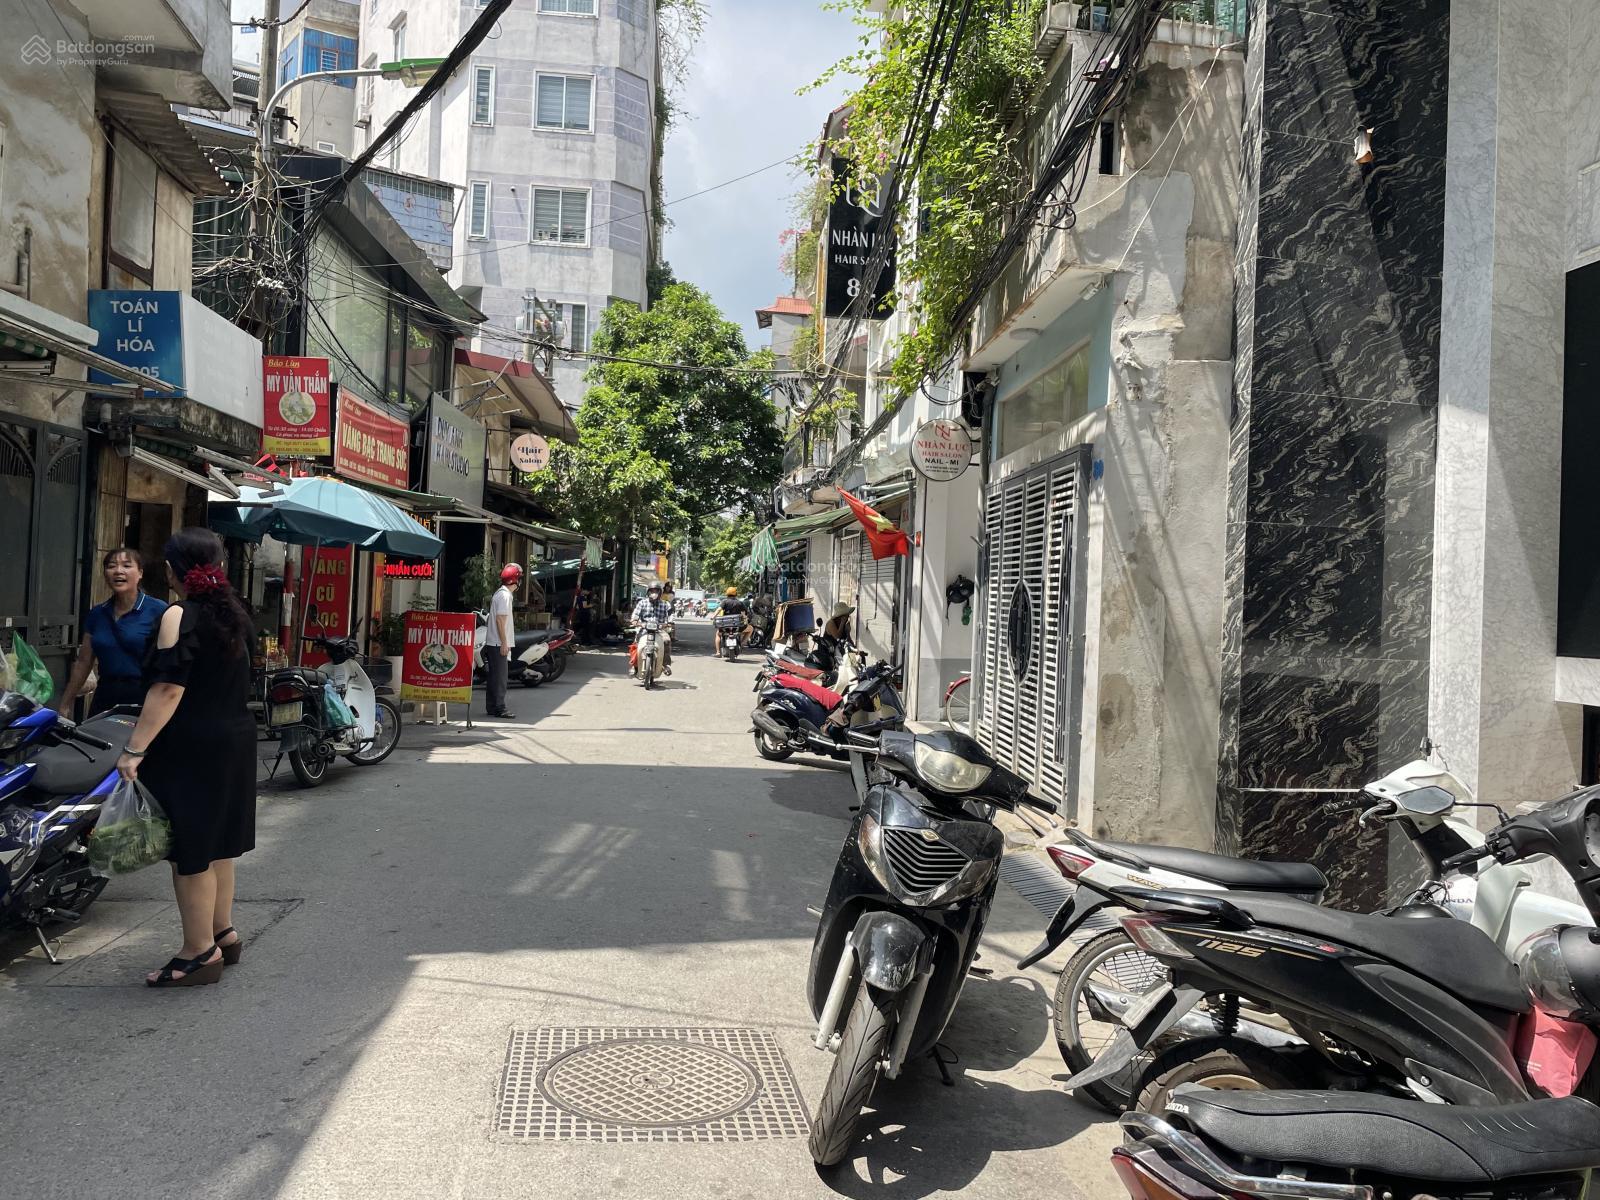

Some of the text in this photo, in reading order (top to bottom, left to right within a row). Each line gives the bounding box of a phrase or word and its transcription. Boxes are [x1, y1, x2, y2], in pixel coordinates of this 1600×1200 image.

[832, 226, 868, 248] NHÀN
[834, 254, 858, 265] HAIR
[110, 298, 158, 314] TOÁN
[128, 316, 143, 332] LÍ
[116, 336, 156, 352] HÓA
[918, 440, 946, 449] NHÀN
[316, 582, 335, 602] CŨ
